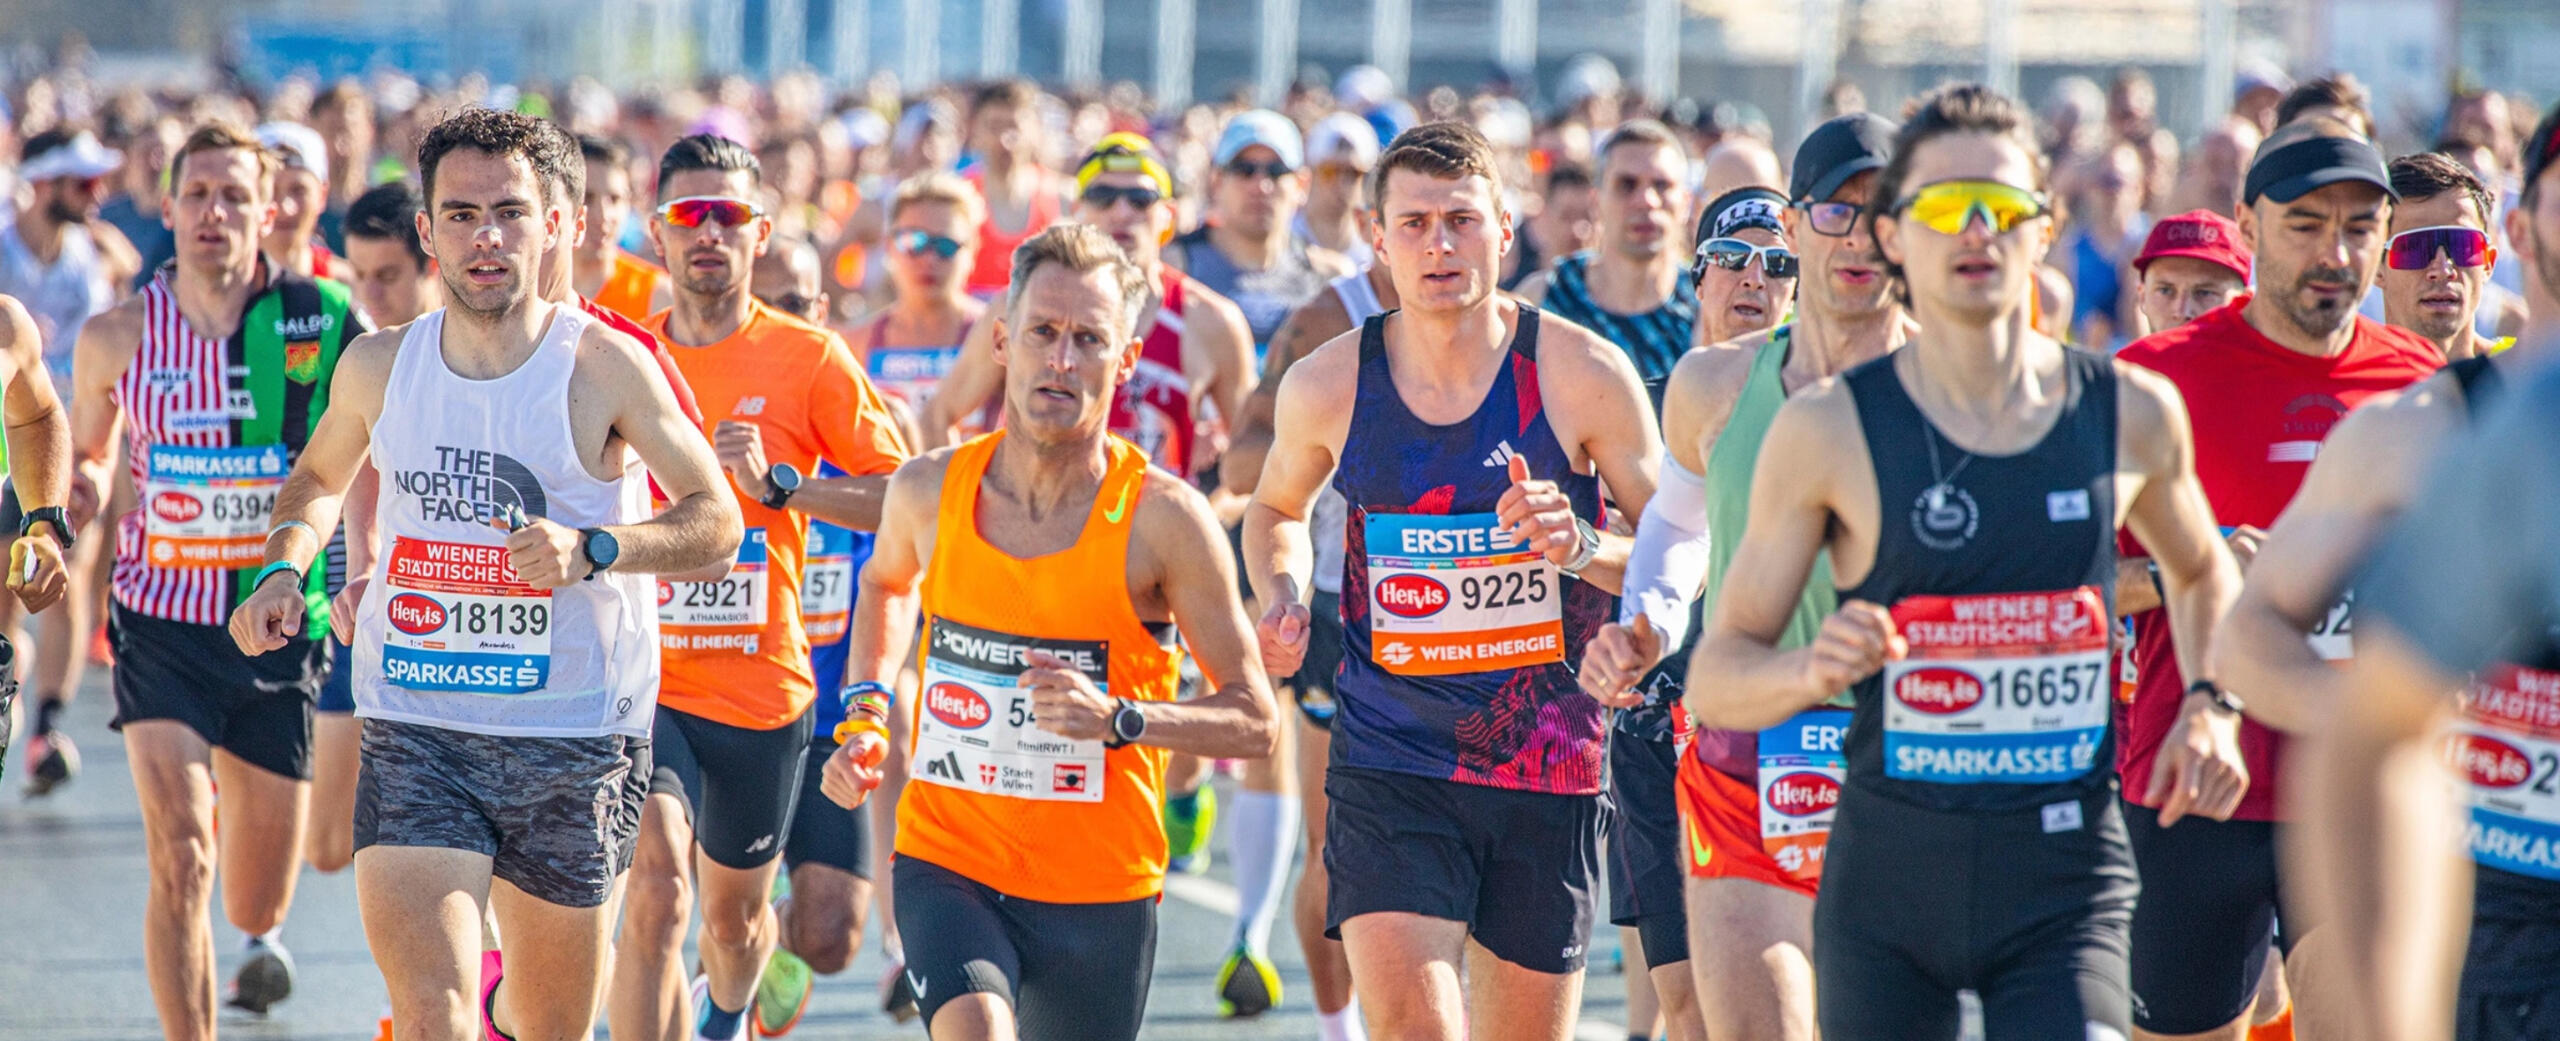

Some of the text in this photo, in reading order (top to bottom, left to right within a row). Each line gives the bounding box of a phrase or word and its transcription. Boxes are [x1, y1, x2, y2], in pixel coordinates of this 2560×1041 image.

[273, 314, 335, 335] SALDO
[153, 452, 257, 475] SPARKASSE
[435, 446, 491, 476] THE
[394, 470, 491, 502] NORTH
[421, 497, 491, 527] FACE
[180, 545, 219, 559] WIEN
[426, 543, 500, 566] WIENER
[1401, 527, 1487, 554] ERSTE
[397, 557, 500, 583] STÄDTISCHE
[684, 579, 752, 607] 2921
[1381, 581, 1445, 610] Hervis
[1460, 568, 1548, 611] 9225
[391, 600, 442, 628] Hervis
[450, 601, 549, 636] 18139
[1953, 597, 2049, 621] WIENER
[1421, 634, 1557, 661] WIEN ENERGIE
[387, 658, 513, 687] SPARKASSE
[1989, 662, 2102, 708] 16657
[930, 687, 987, 721] Hervis
[1900, 675, 1980, 708] Hervis
[1002, 766, 1034, 778] Stadt
[1896, 746, 2066, 775] SPARKASSE
[1002, 780, 1033, 791] Wien
[1773, 781, 1838, 807] Hervis
